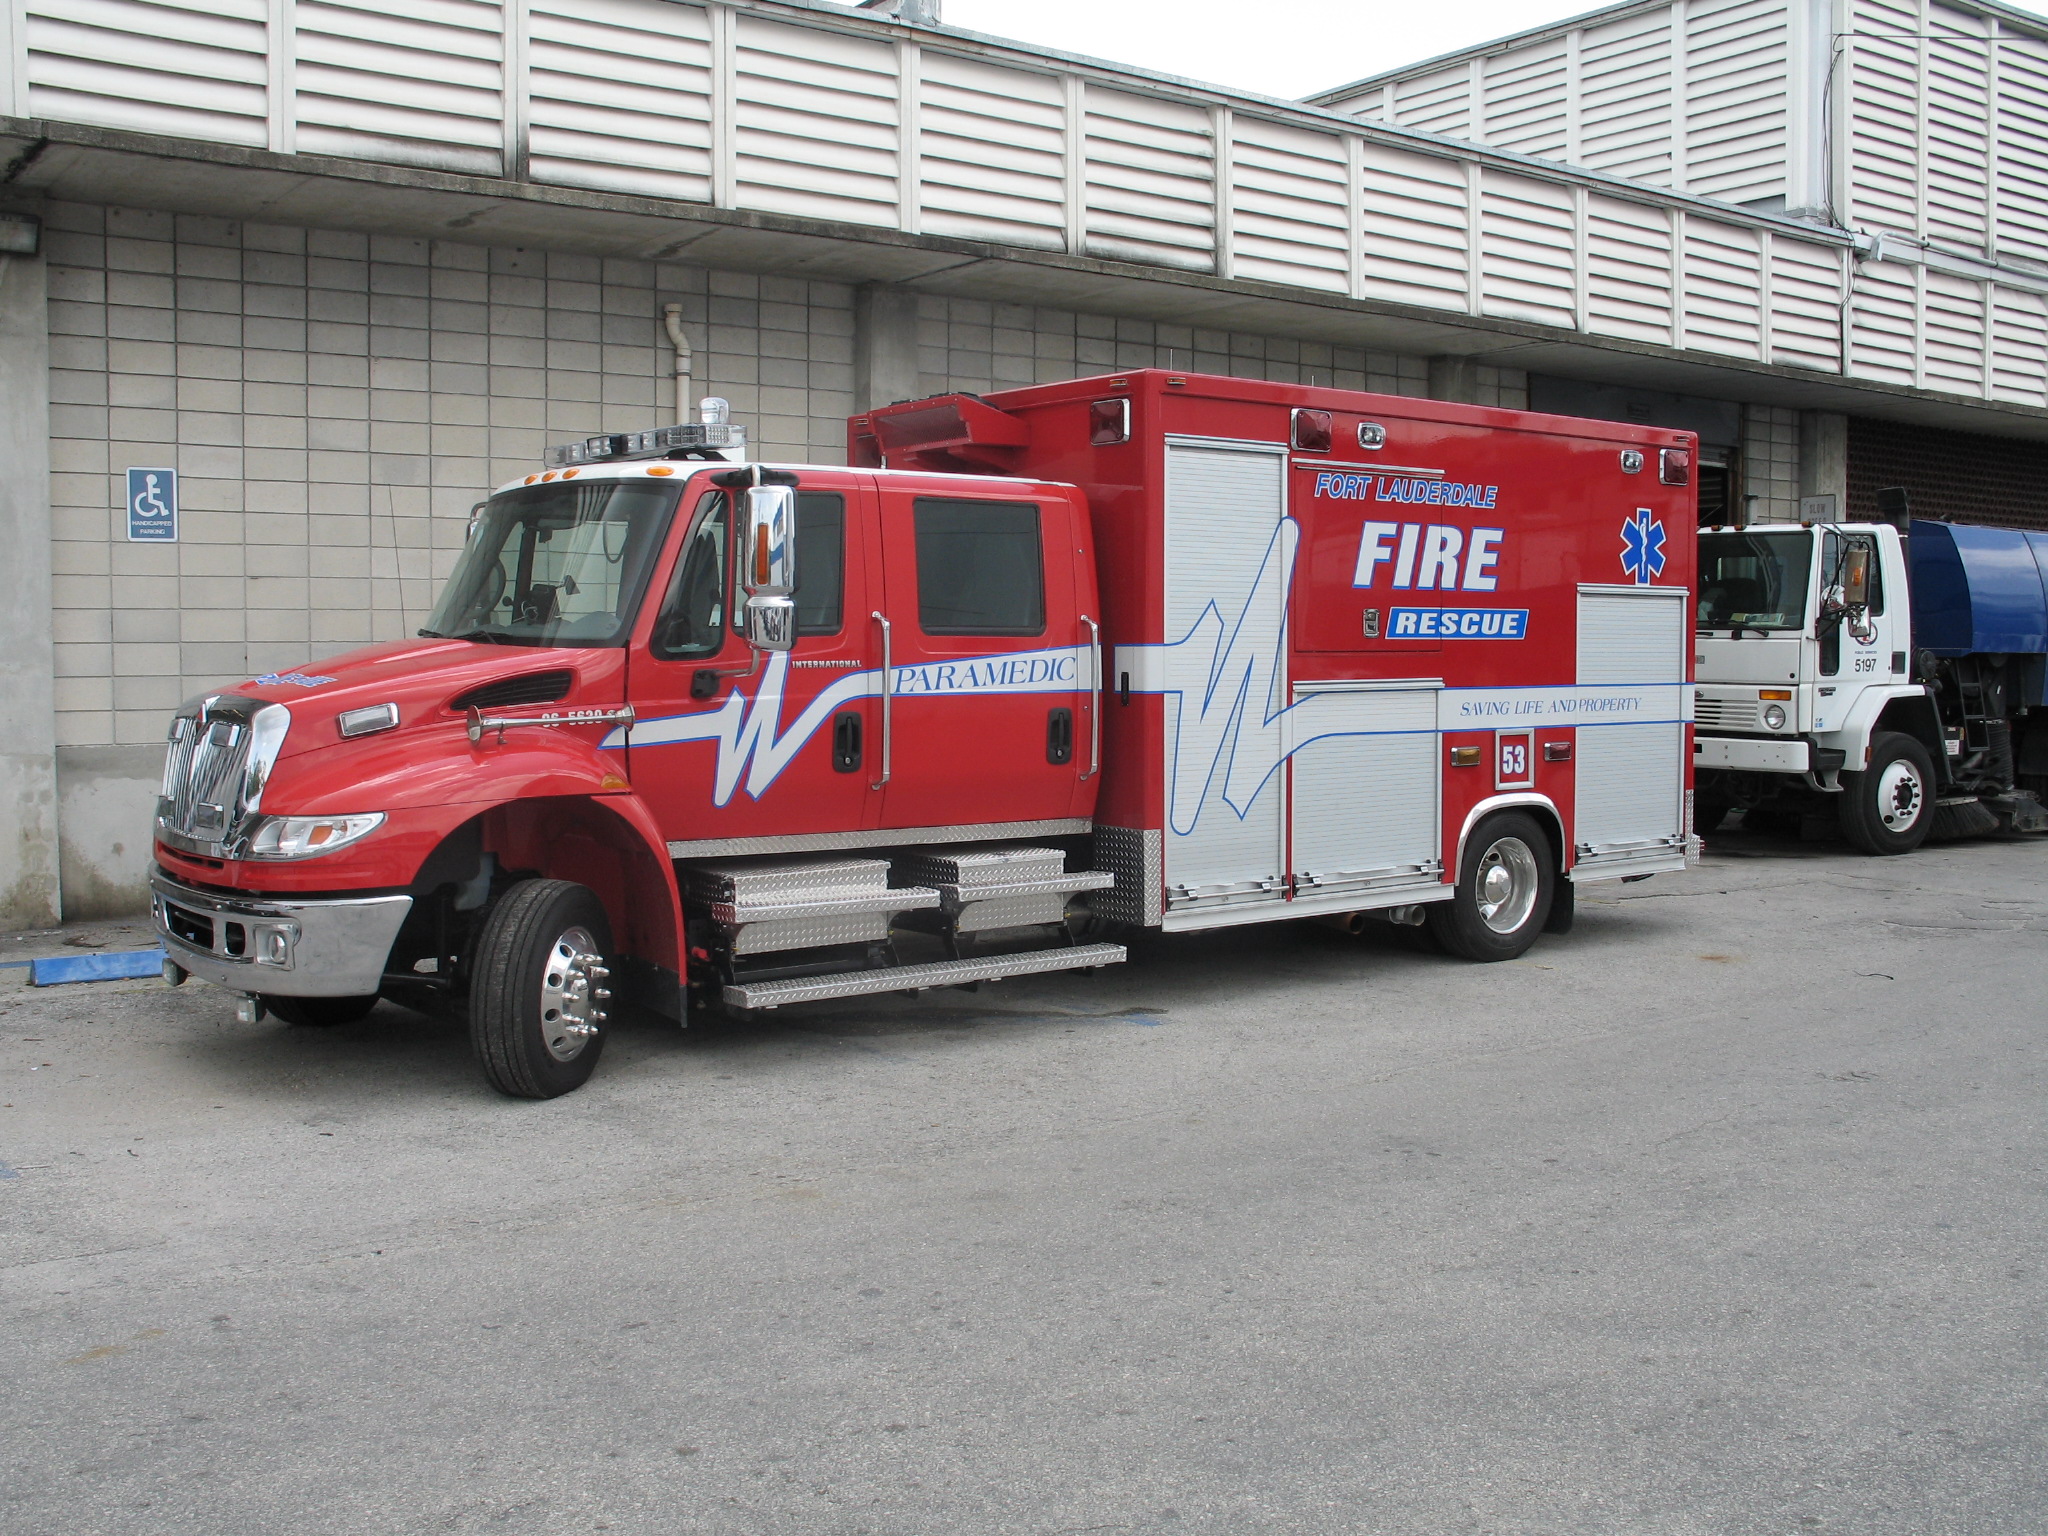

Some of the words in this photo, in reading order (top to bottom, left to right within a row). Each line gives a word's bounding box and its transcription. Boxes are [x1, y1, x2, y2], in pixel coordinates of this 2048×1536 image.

[1314, 472, 1372, 500] FORT
[1375, 477, 1498, 509] LAUDERDALE
[1809, 503, 1826, 514] SLOW
[1352, 520, 1505, 592] FIRE
[1395, 612, 1519, 635] RESCUE
[791, 659, 862, 669] INTERNATIONAL
[895, 656, 1076, 693] PARAMEDIC
[1854, 658, 1877, 673] 5197
[1460, 701, 1510, 717] SAVING
[1514, 700, 1544, 715] LIFE
[1548, 699, 1577, 713] AND
[1578, 697, 1641, 712] PROPERTY
[1501, 745, 1526, 775] 53
